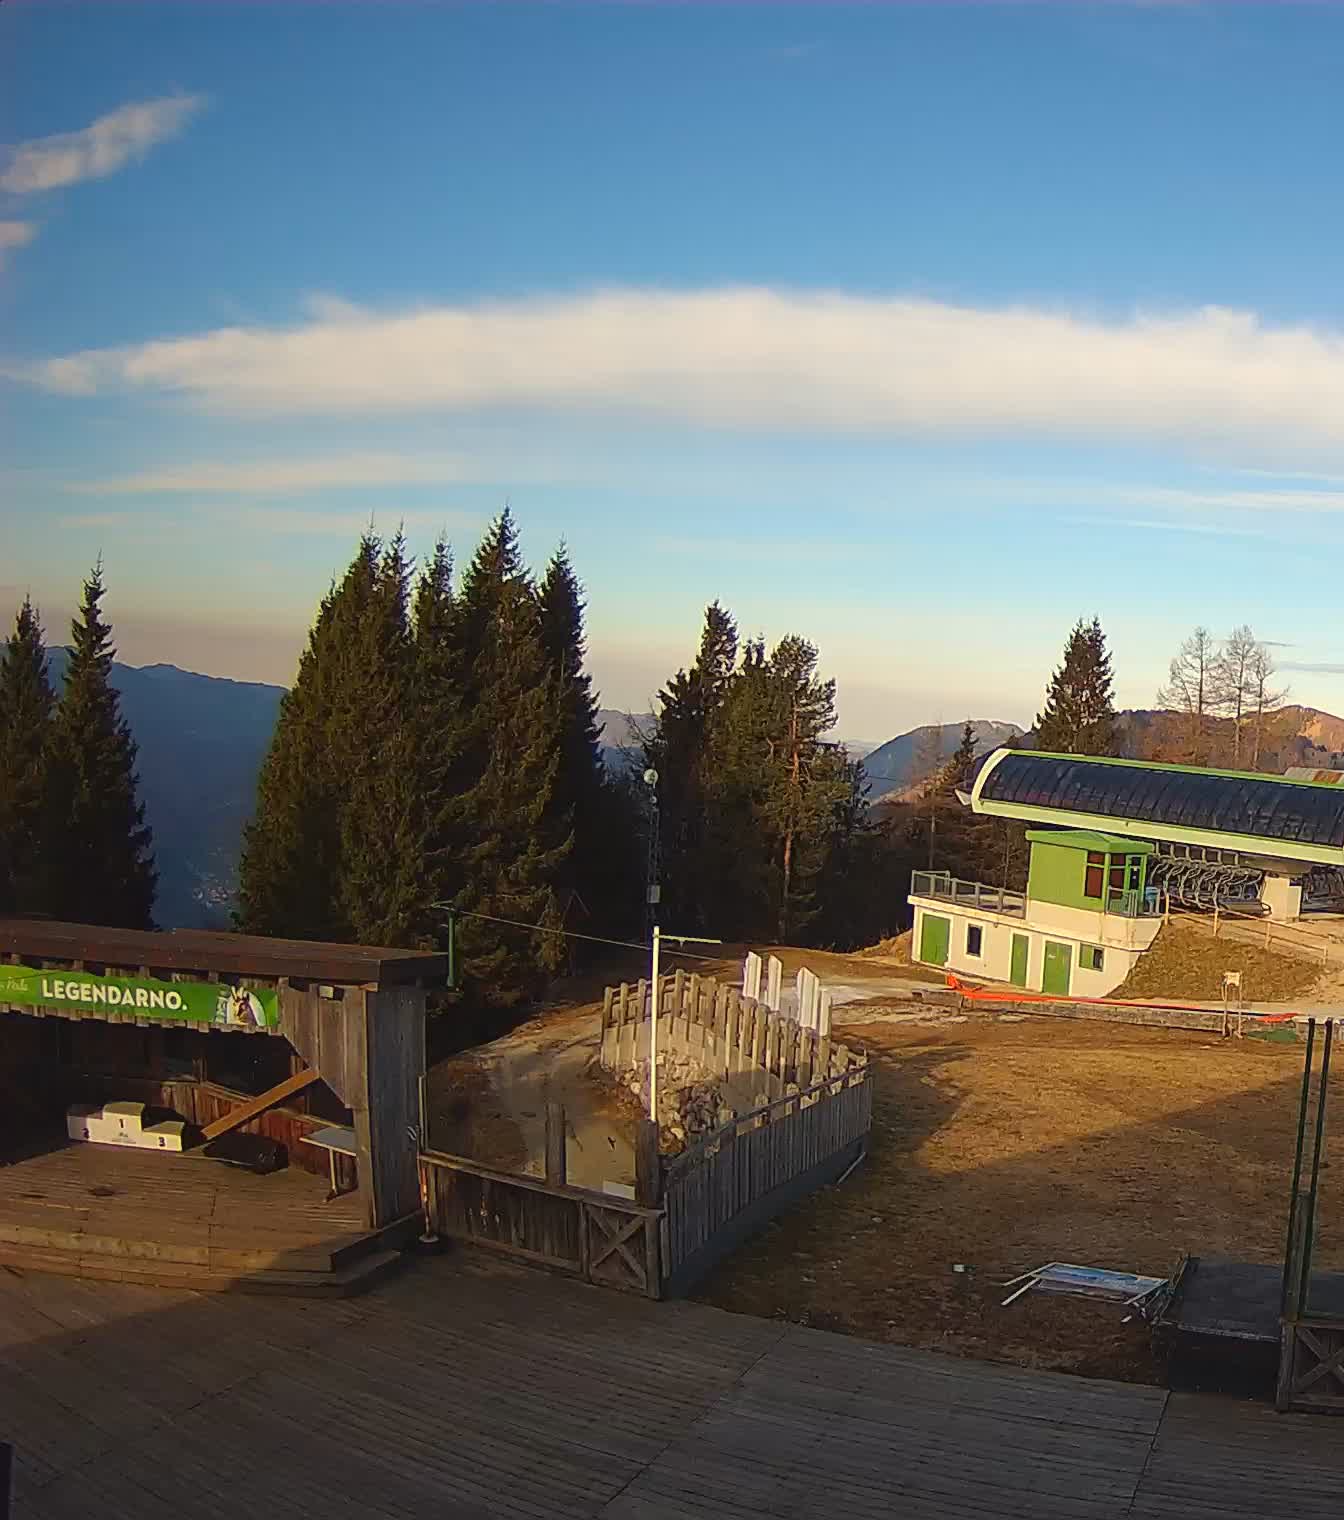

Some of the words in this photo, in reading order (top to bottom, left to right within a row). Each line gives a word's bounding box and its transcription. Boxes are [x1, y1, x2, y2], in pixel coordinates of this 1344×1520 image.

[42, 978, 188, 1011] LEGENDARNO.
[118, 1118, 124, 1129] 1
[158, 1136, 165, 1147] 3
